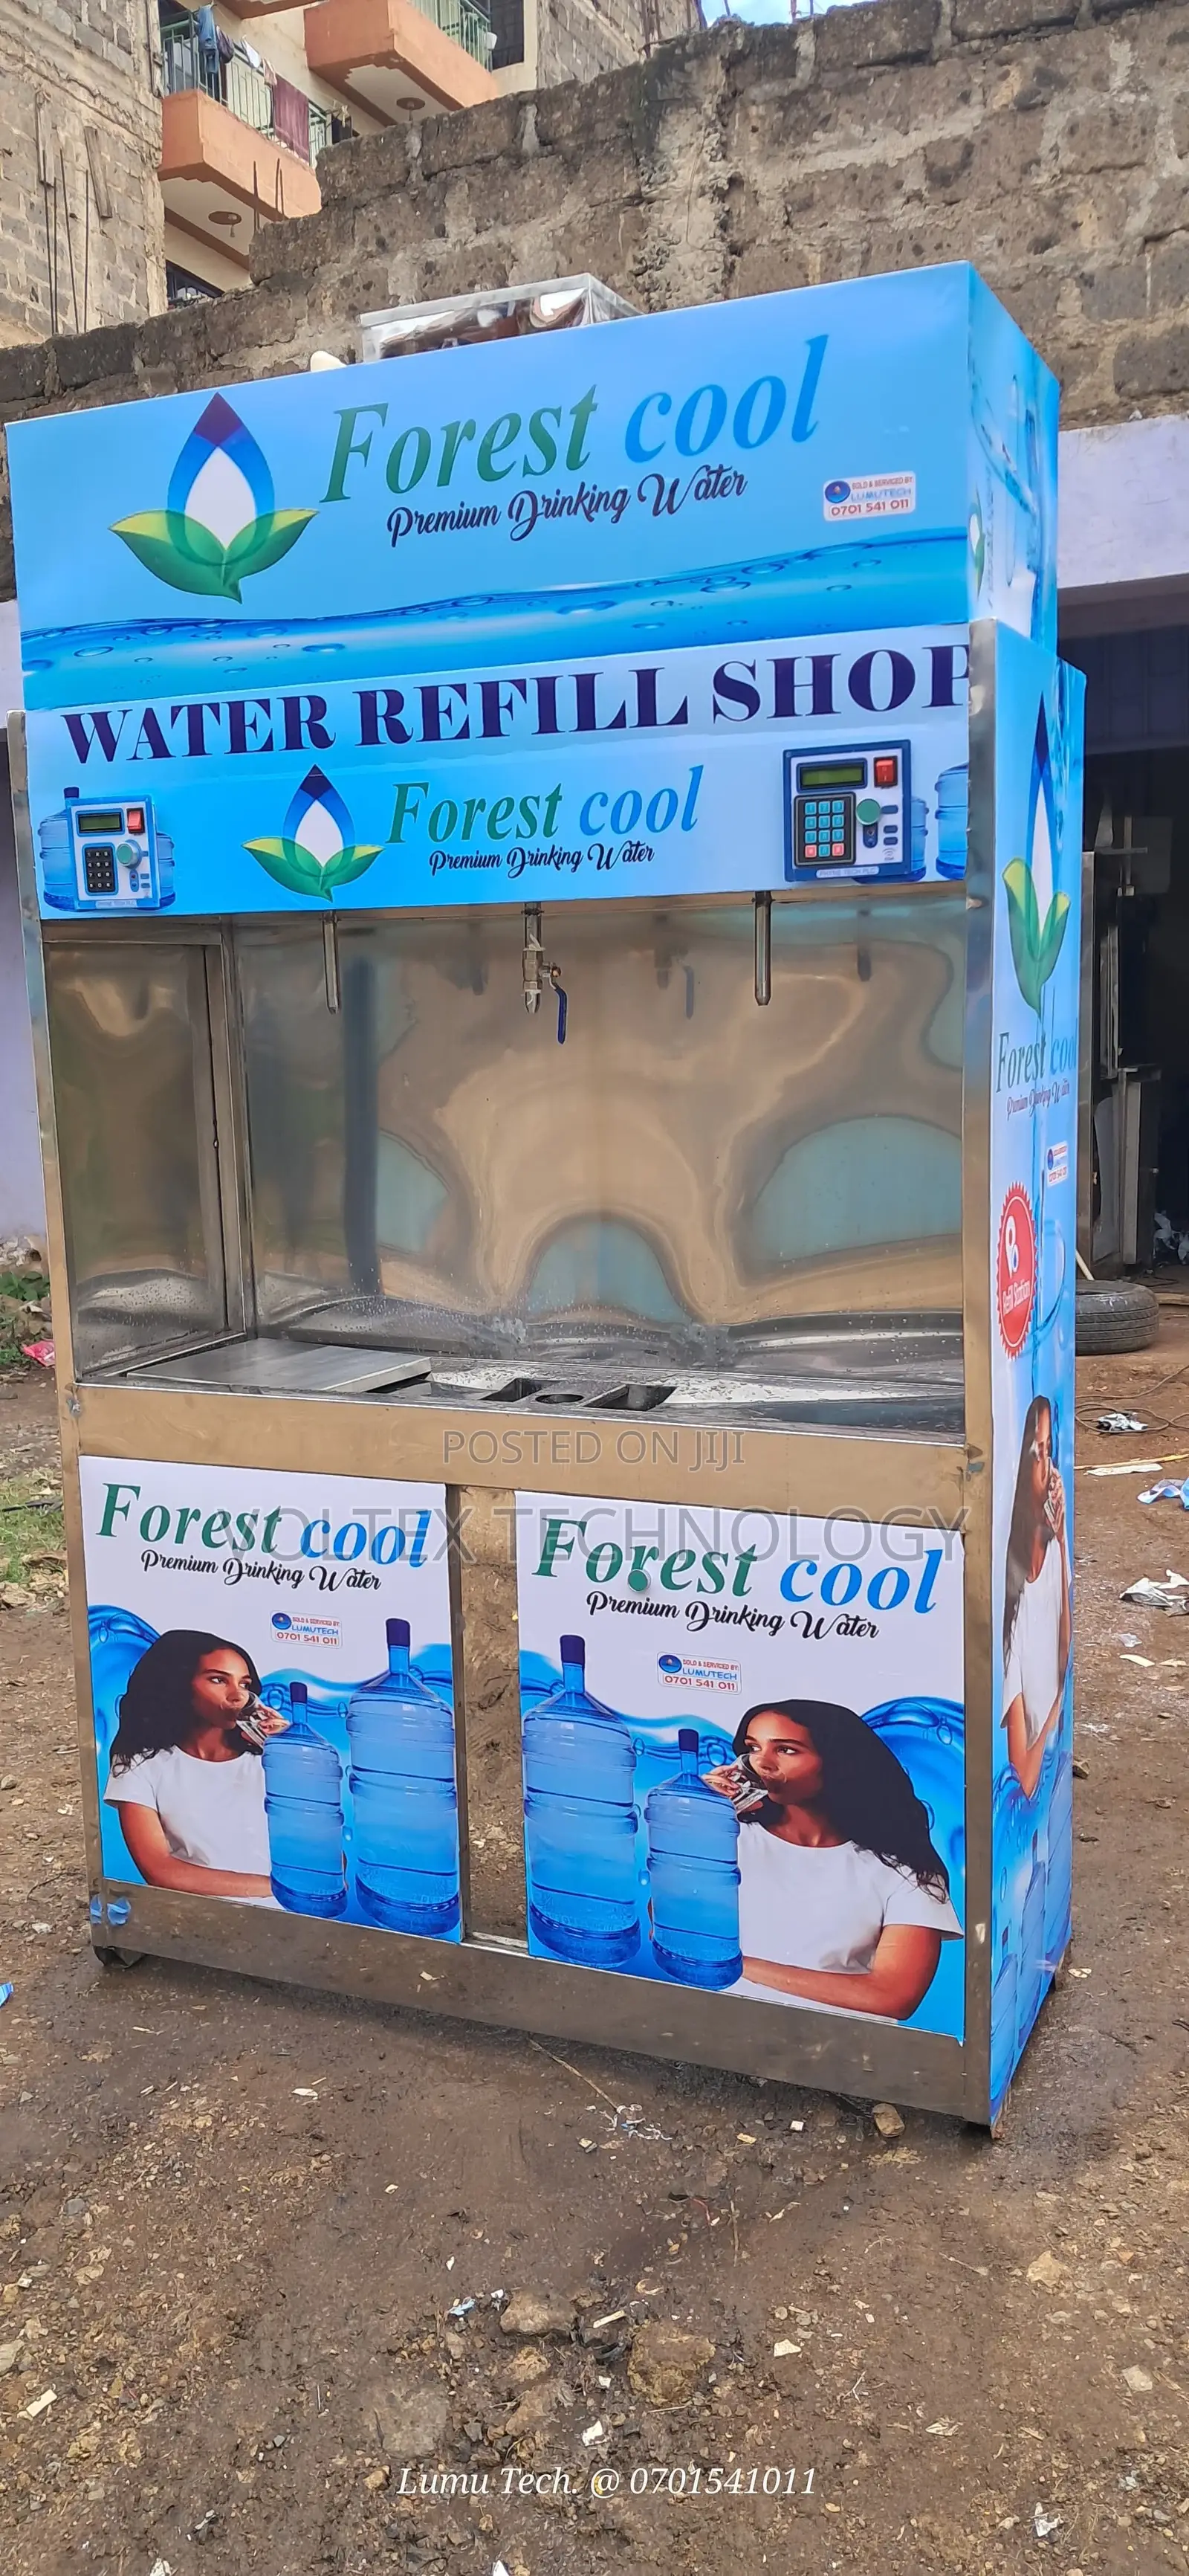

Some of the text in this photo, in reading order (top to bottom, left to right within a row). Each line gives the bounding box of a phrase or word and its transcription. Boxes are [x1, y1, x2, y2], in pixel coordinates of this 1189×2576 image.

[320, 335, 829, 503] Forest cool
[386, 463, 748, 548] Premium Drinking Water
[831, 498, 909, 516] 0701 541 011
[851, 488, 911, 502] LUMUTECH
[60, 644, 970, 764] WATER REFILL SHOP
[385, 764, 704, 845] Forest cool
[429, 839, 655, 879] Premium Drinking Water
[996, 1031, 1046, 1093] Forest
[95, 1482, 432, 1568] Forest cool
[140, 1549, 381, 1592] Premium Drinking Water
[531, 1517, 943, 1614] Forest cool
[276, 1632, 300, 1641] 0701
[304, 1634, 319, 1642] 541
[291, 1624, 339, 1636] LUMUTECH
[586, 1590, 879, 1640] Premium Drinking Water
[664, 1675, 734, 1691] 0701 541 011
[682, 1668, 737, 1680] LUMUTECH
